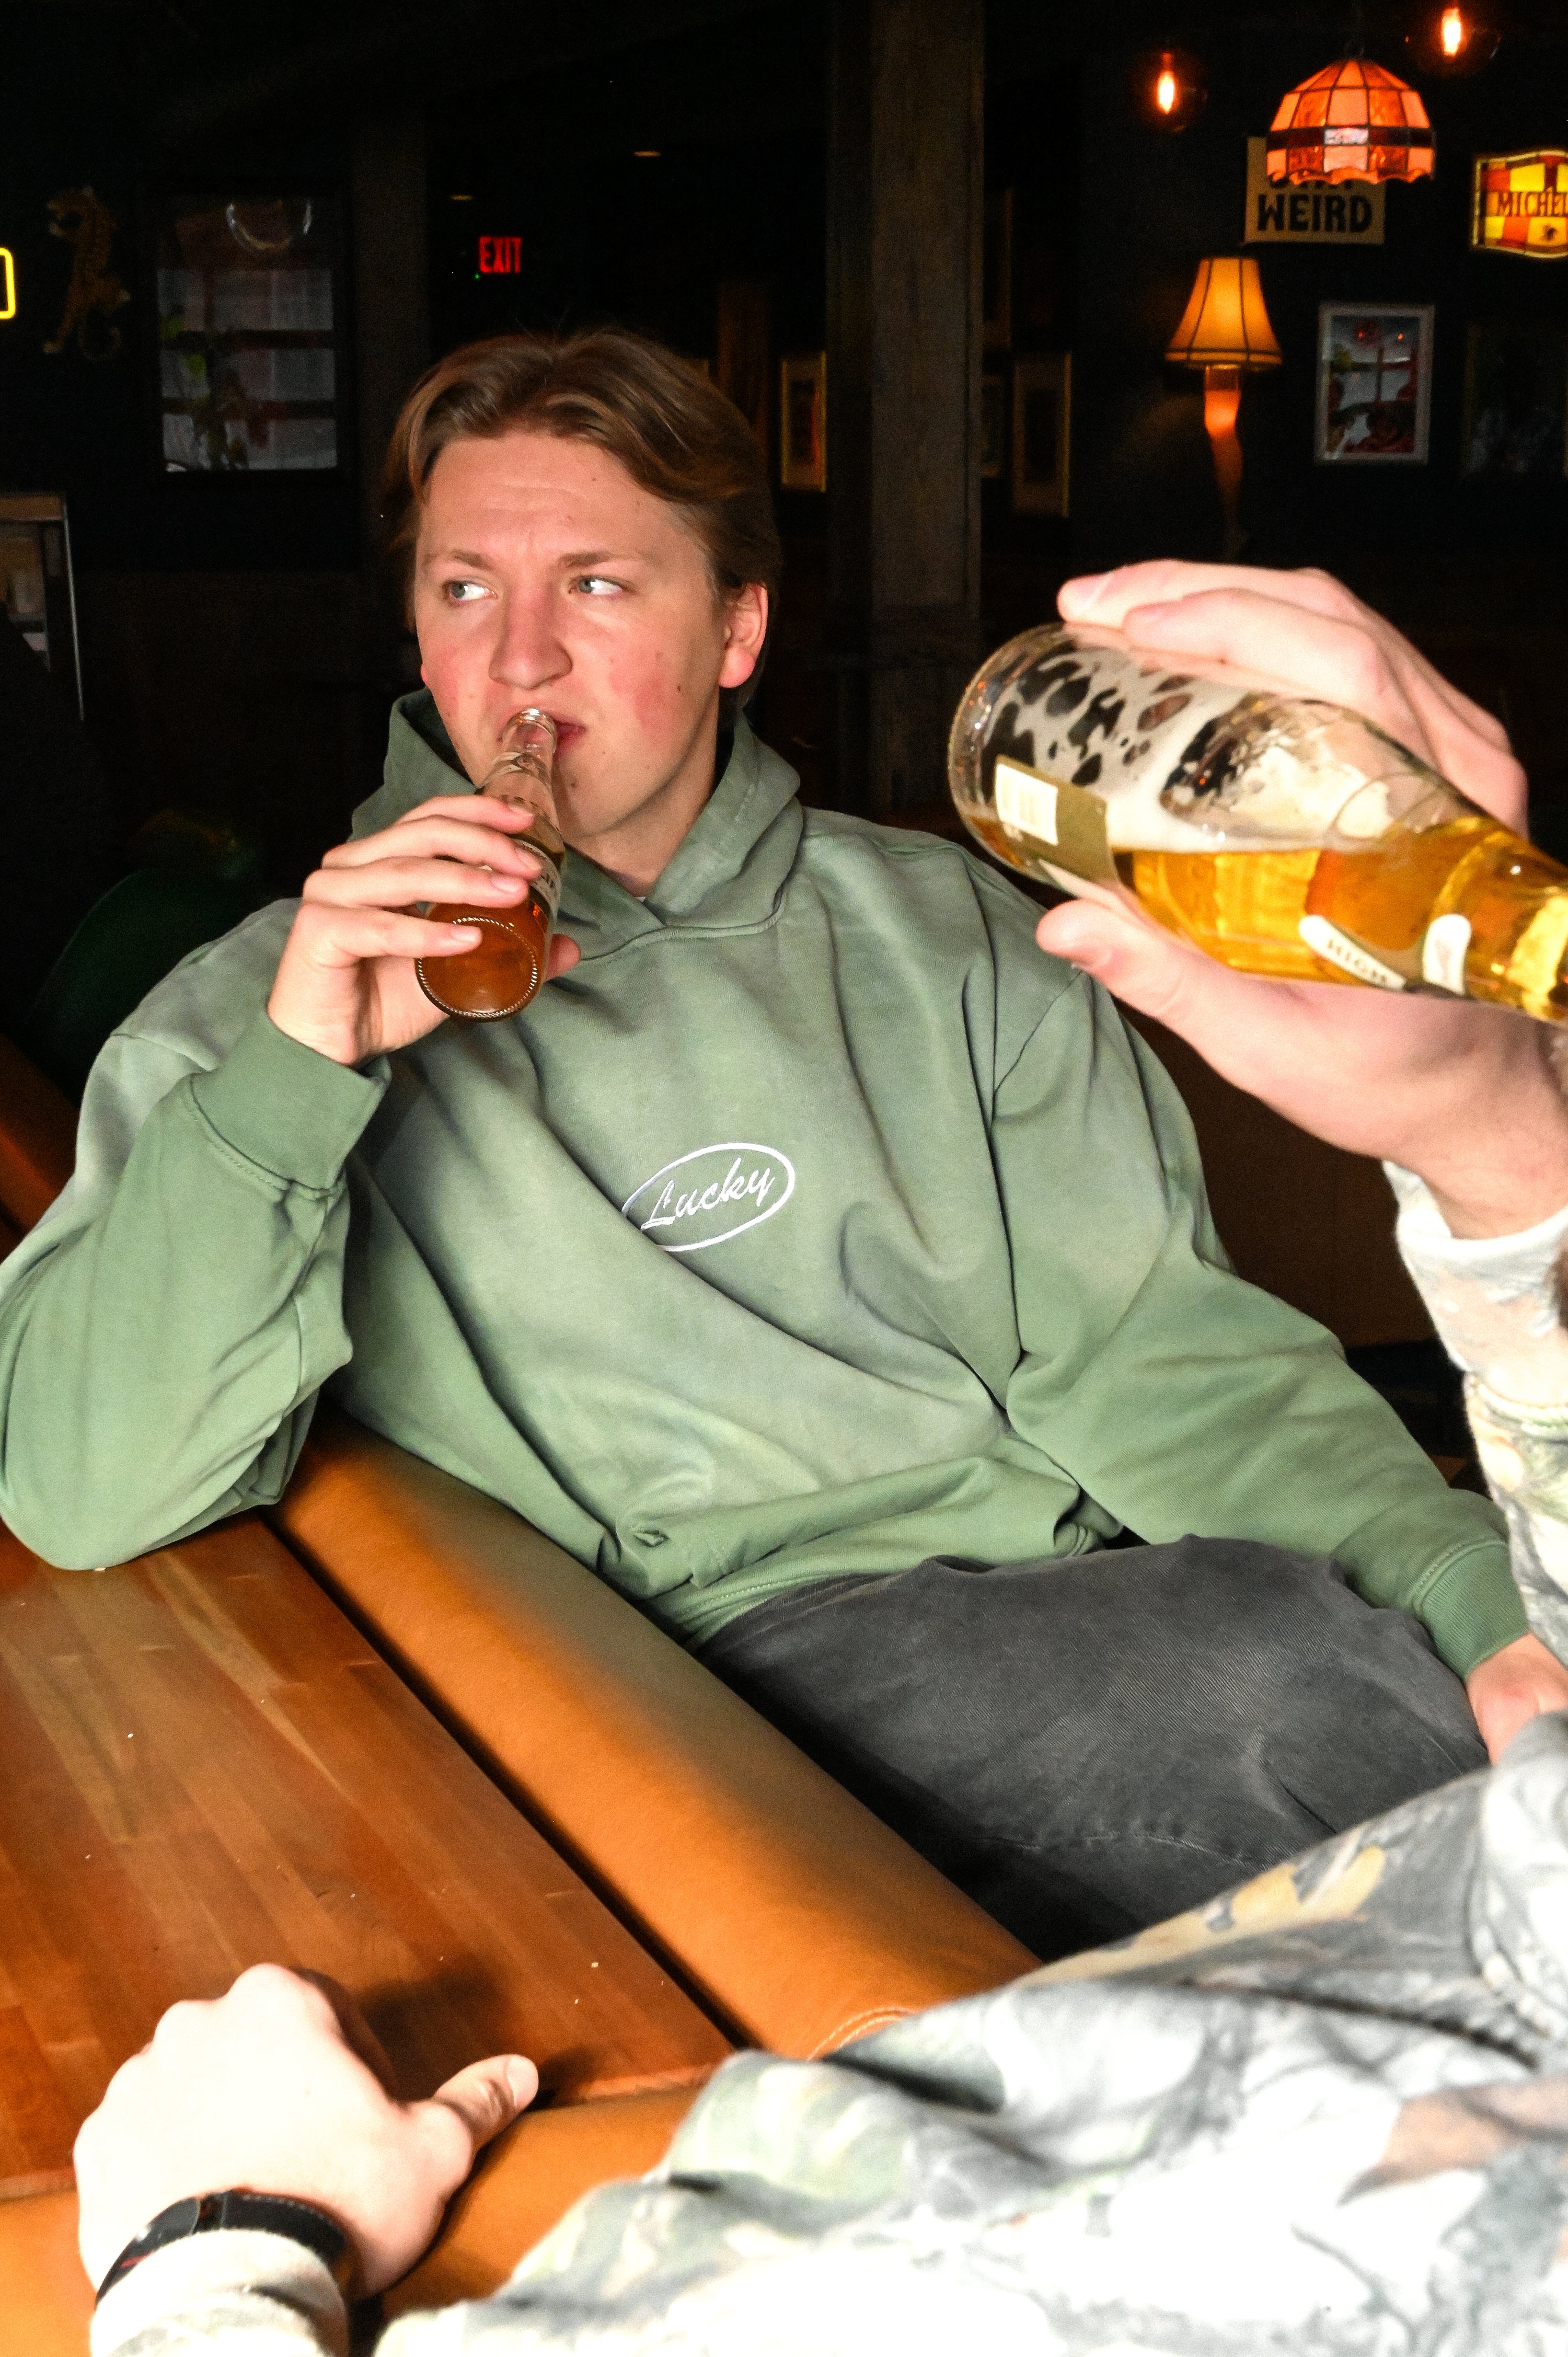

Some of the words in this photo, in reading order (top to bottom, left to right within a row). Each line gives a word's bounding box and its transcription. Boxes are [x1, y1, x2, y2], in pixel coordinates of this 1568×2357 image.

[1257, 193, 1373, 233] WEIRD
[479, 236, 522, 273] EXIT
[640, 1157, 775, 1231] Lucky
